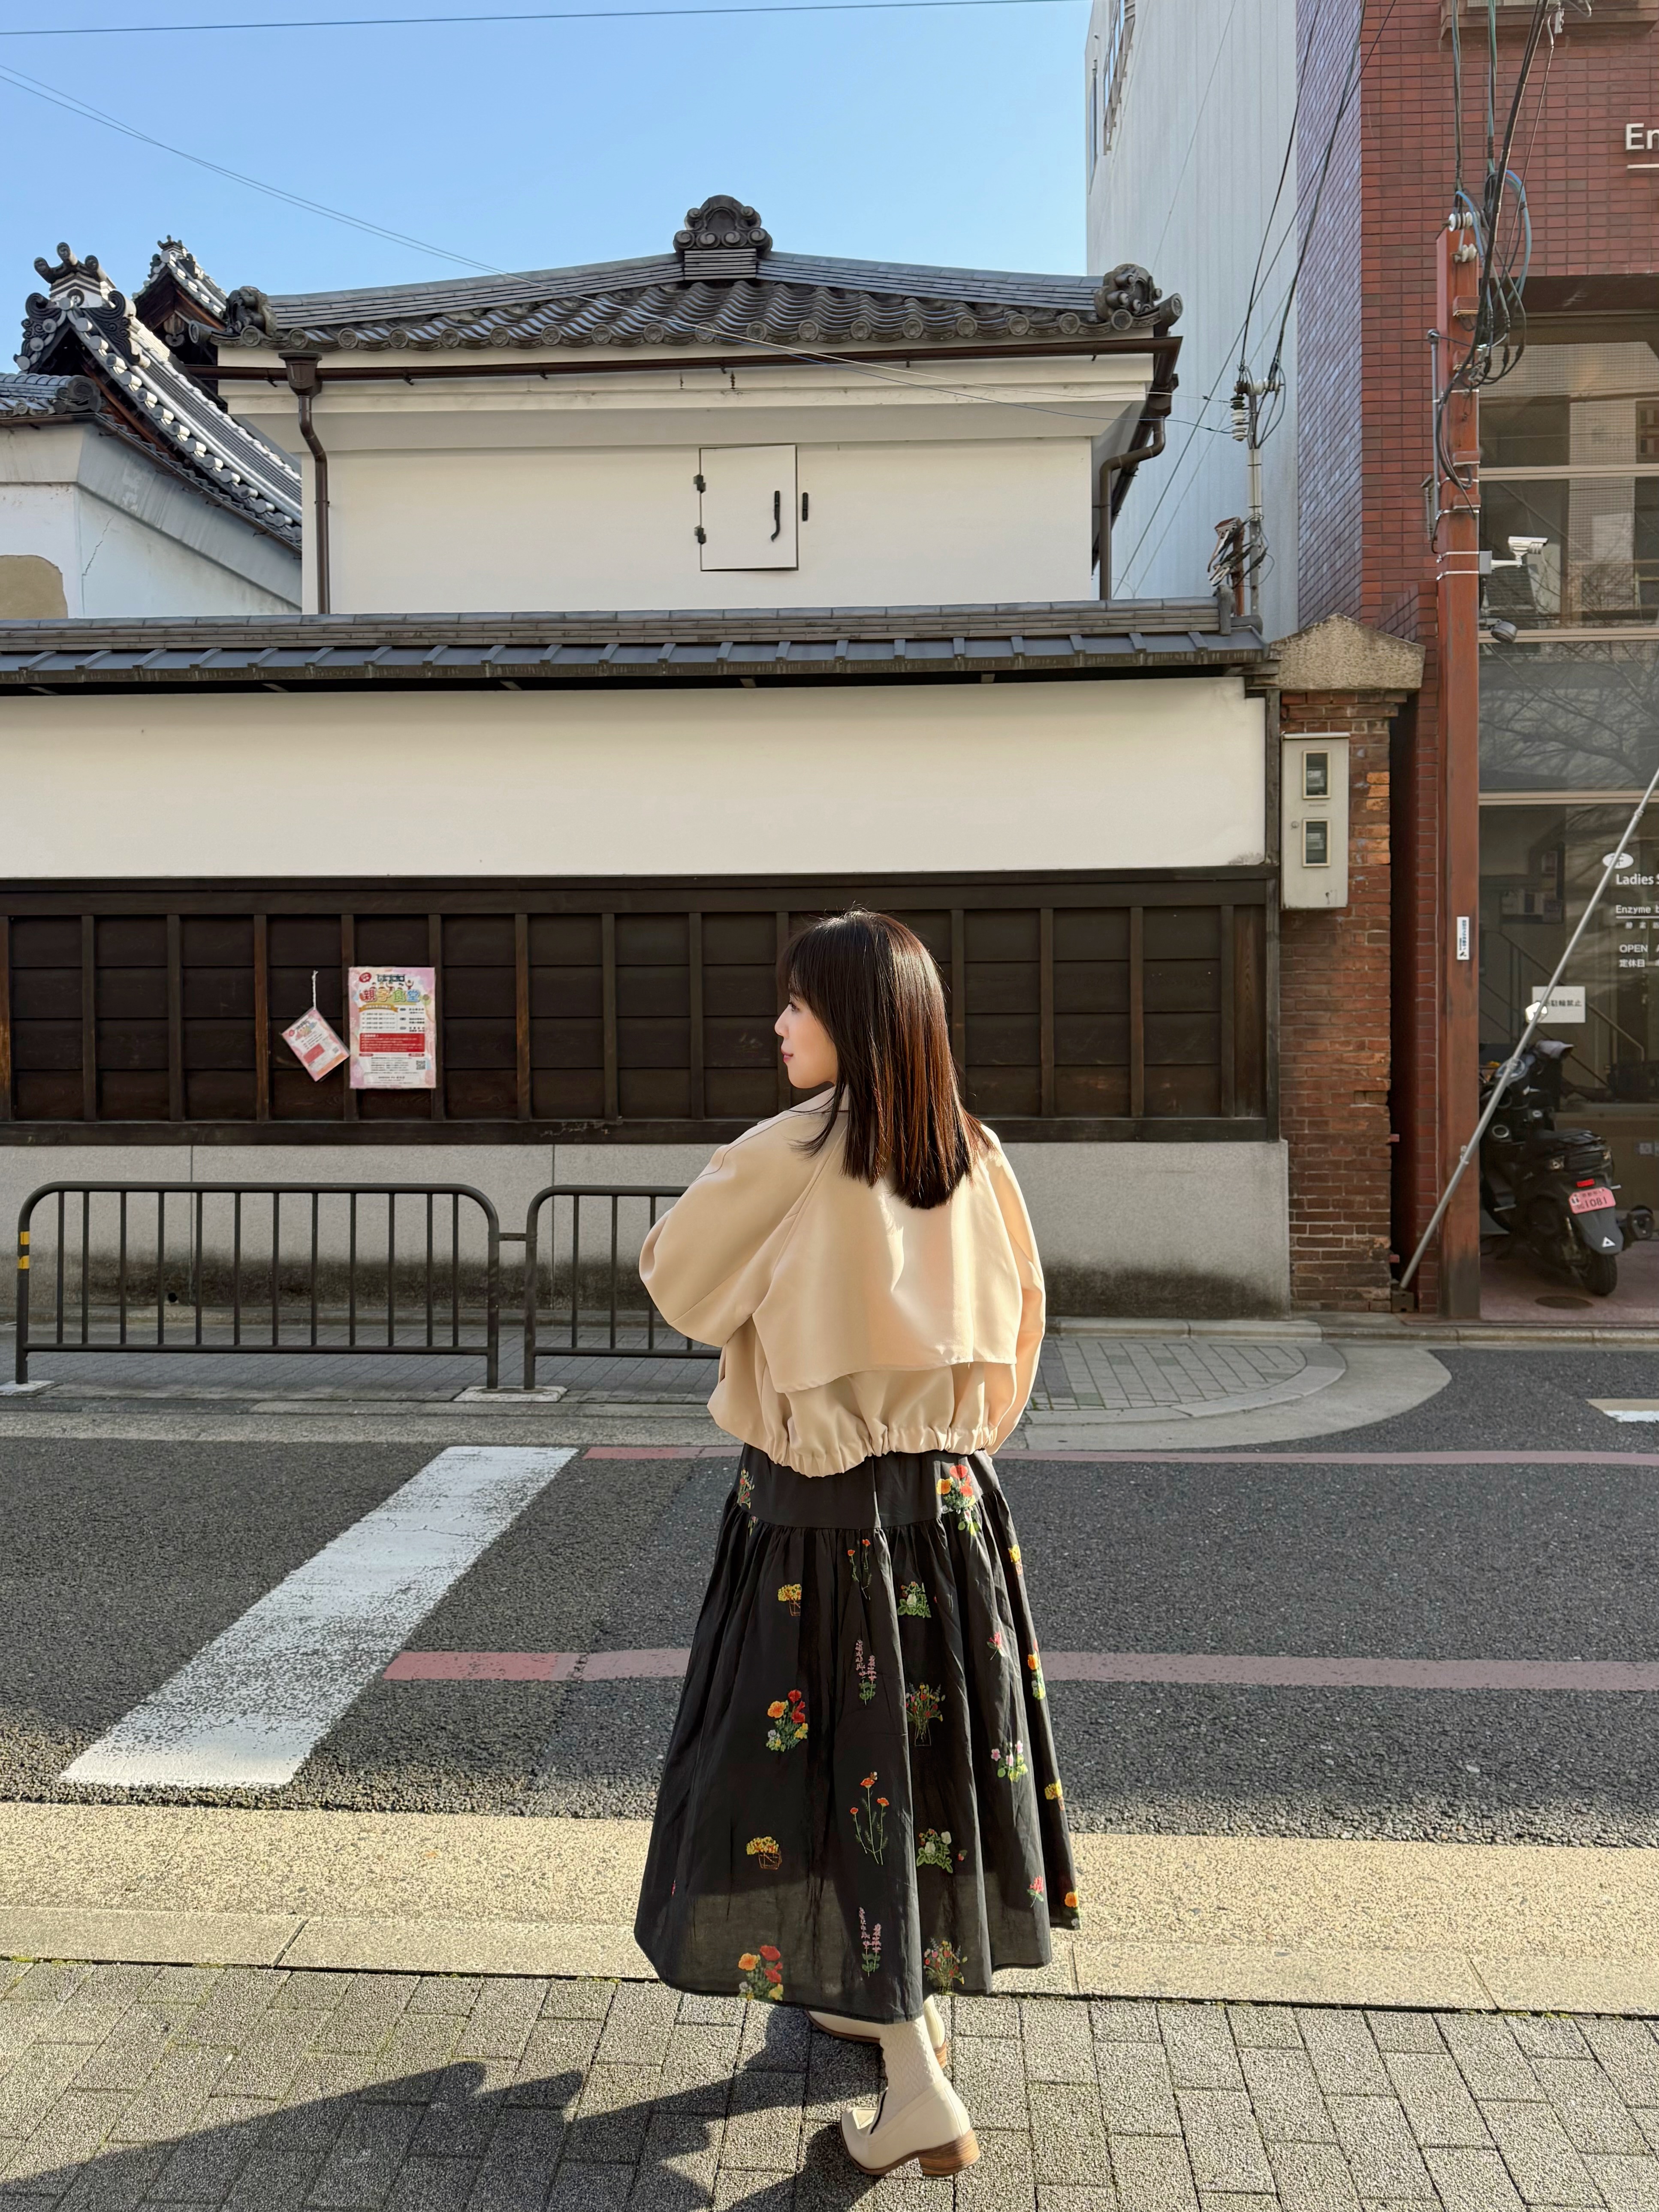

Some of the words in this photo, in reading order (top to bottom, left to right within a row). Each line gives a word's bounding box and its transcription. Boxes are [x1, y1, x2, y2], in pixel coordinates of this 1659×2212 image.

[1616, 873, 1654, 885] Ladies
[1616, 904, 1651, 914] Enzyme
[1619, 944, 1648, 953] OPEN
[1619, 959, 1645, 967] 定休日
[364, 988, 420, 1003] 親子食堂
